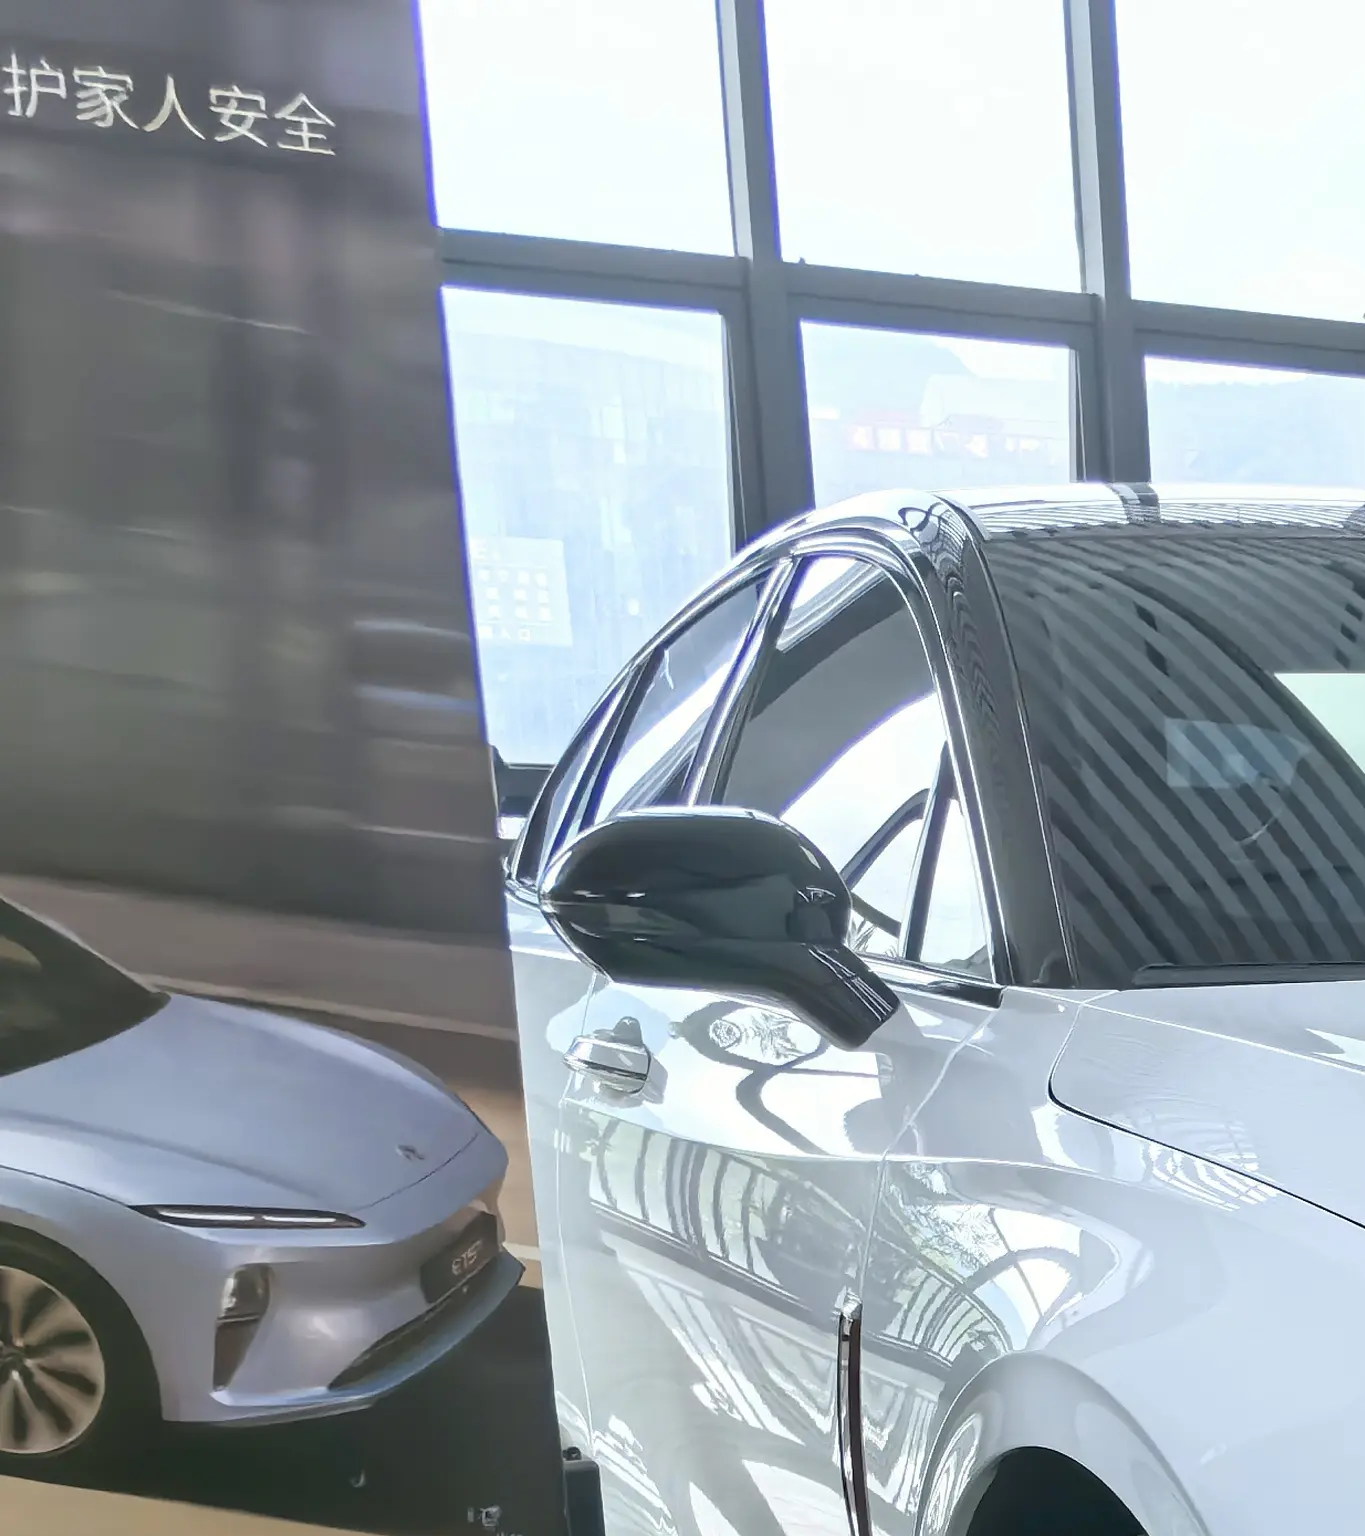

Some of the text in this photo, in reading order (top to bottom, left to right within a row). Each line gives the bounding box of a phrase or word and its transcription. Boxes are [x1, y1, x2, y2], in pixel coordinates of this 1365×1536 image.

[2, 51, 337, 156] 护家人安全
